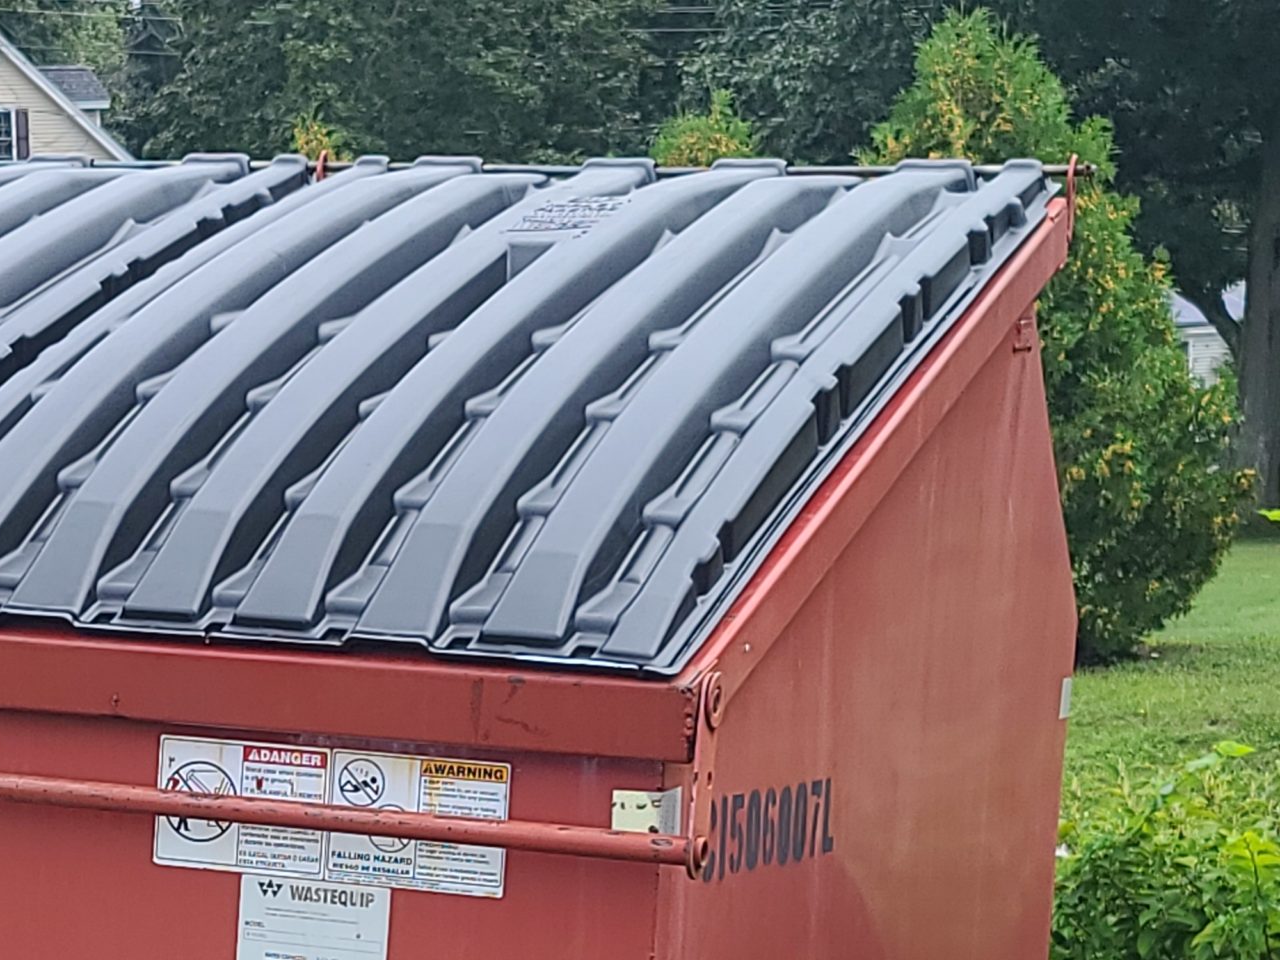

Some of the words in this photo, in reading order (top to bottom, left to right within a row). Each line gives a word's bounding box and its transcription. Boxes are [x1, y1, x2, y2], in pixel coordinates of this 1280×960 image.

[260, 749, 322, 767] DANGER
[433, 763, 504, 780] WARNING
[331, 851, 370, 863] FALLING
[373, 854, 413, 866] HAZARD
[289, 885, 375, 908] WASTEQUIP
